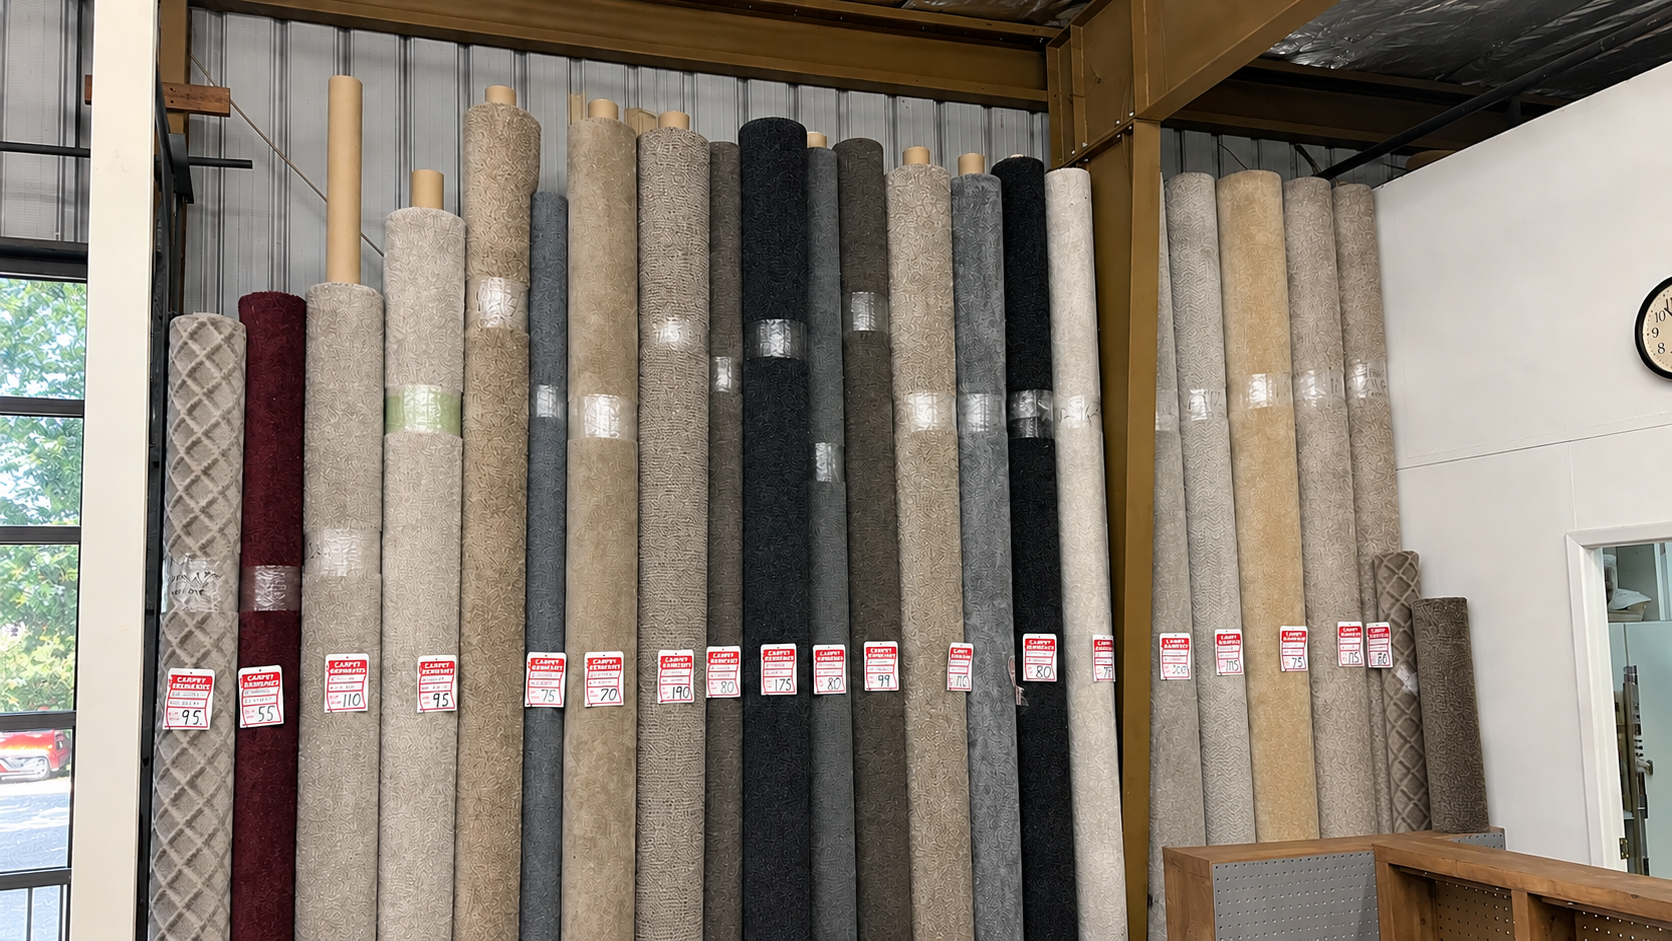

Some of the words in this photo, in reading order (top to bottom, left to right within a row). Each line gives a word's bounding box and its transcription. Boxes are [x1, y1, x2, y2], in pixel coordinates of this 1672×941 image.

[1655, 310, 1666, 323] 10
[1651, 327, 1659, 338] 9
[1657, 342, 1665, 354] 8
[1292, 657, 1303, 668] 75
[1036, 666, 1051, 678] 80
[720, 681, 734, 693] 80
[775, 678, 791, 691] 175
[828, 677, 841, 691] 80
[878, 675, 890, 687] 99
[541, 689, 556, 702] 75
[600, 688, 617, 701] 70
[672, 686, 690, 699] 190
[343, 693, 361, 707] 110
[433, 693, 449, 707] 95
[258, 706, 275, 722] 55
